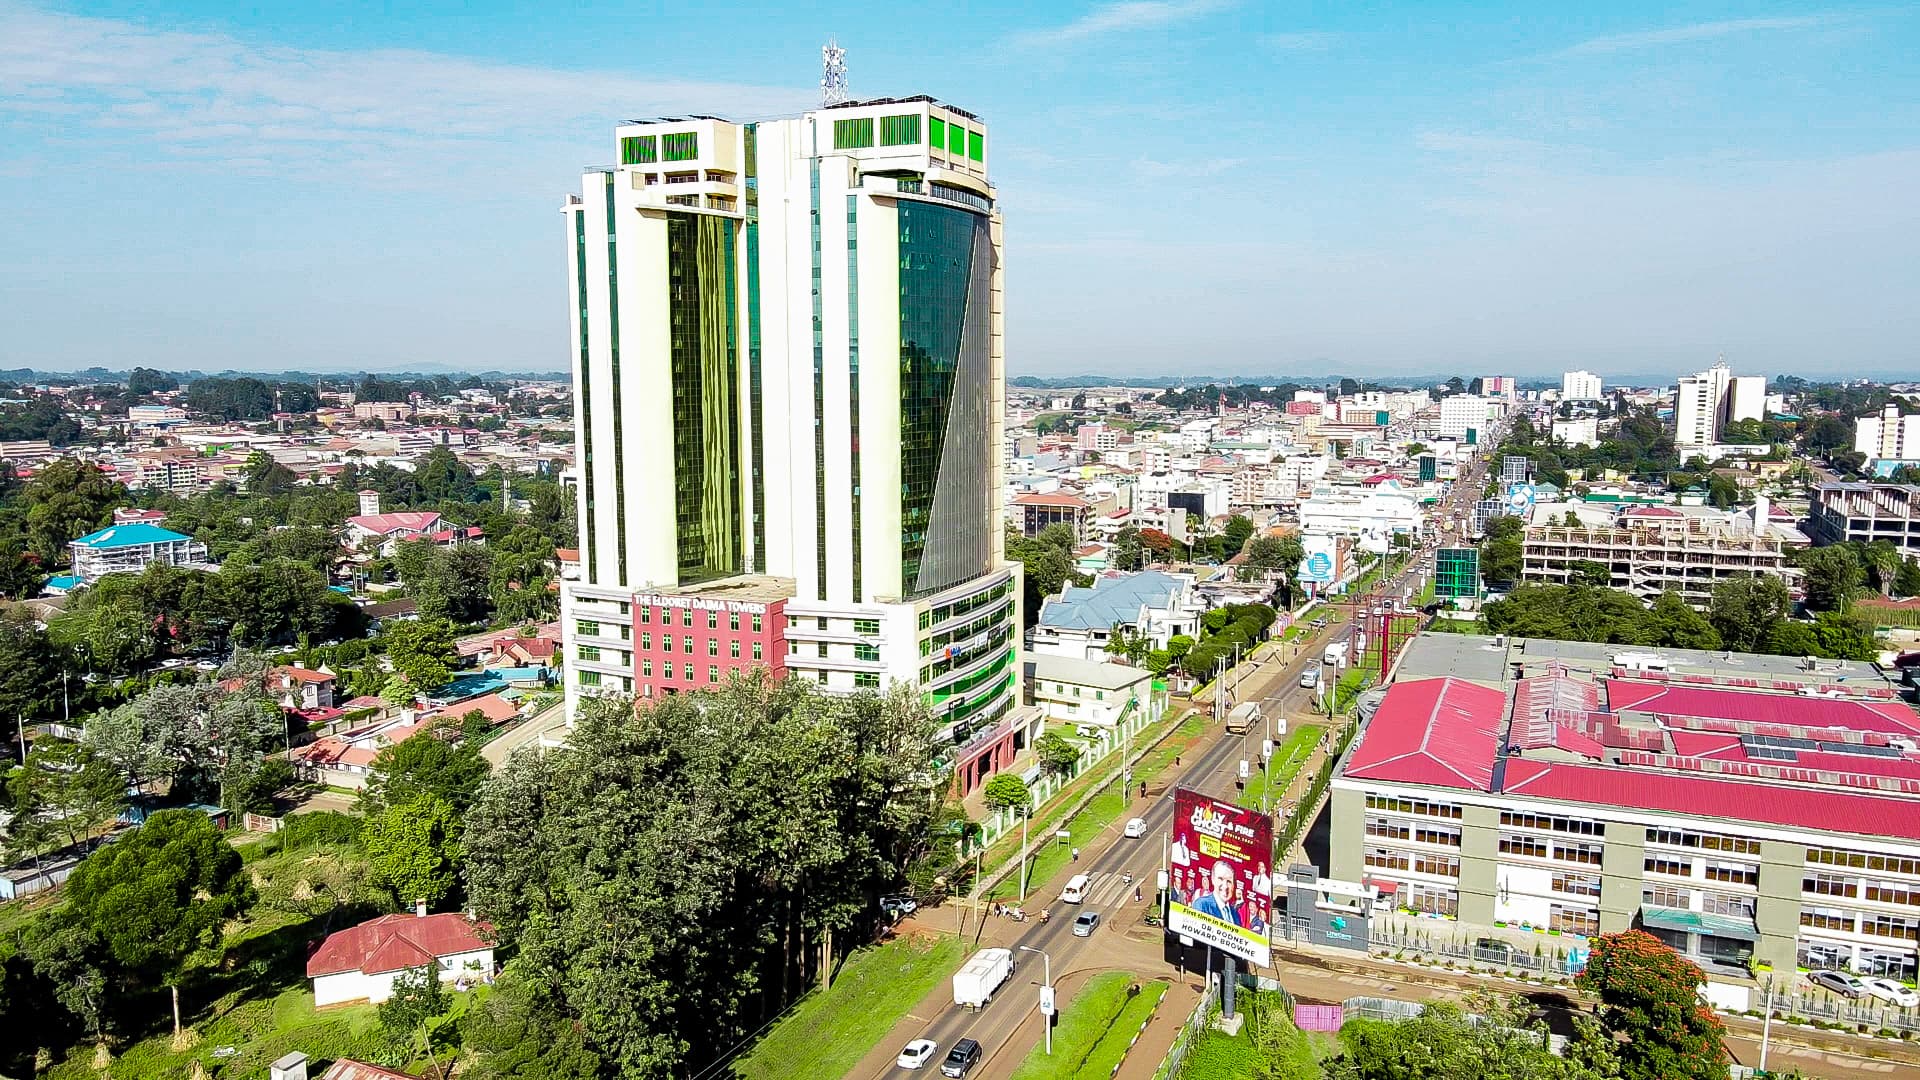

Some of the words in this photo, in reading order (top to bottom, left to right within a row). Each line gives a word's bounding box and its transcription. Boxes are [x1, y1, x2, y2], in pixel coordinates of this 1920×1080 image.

[635, 595, 651, 606] THE
[653, 596, 692, 608] ELDORET
[693, 599, 725, 611] DAIMA
[727, 603, 766, 614] TOWERS
